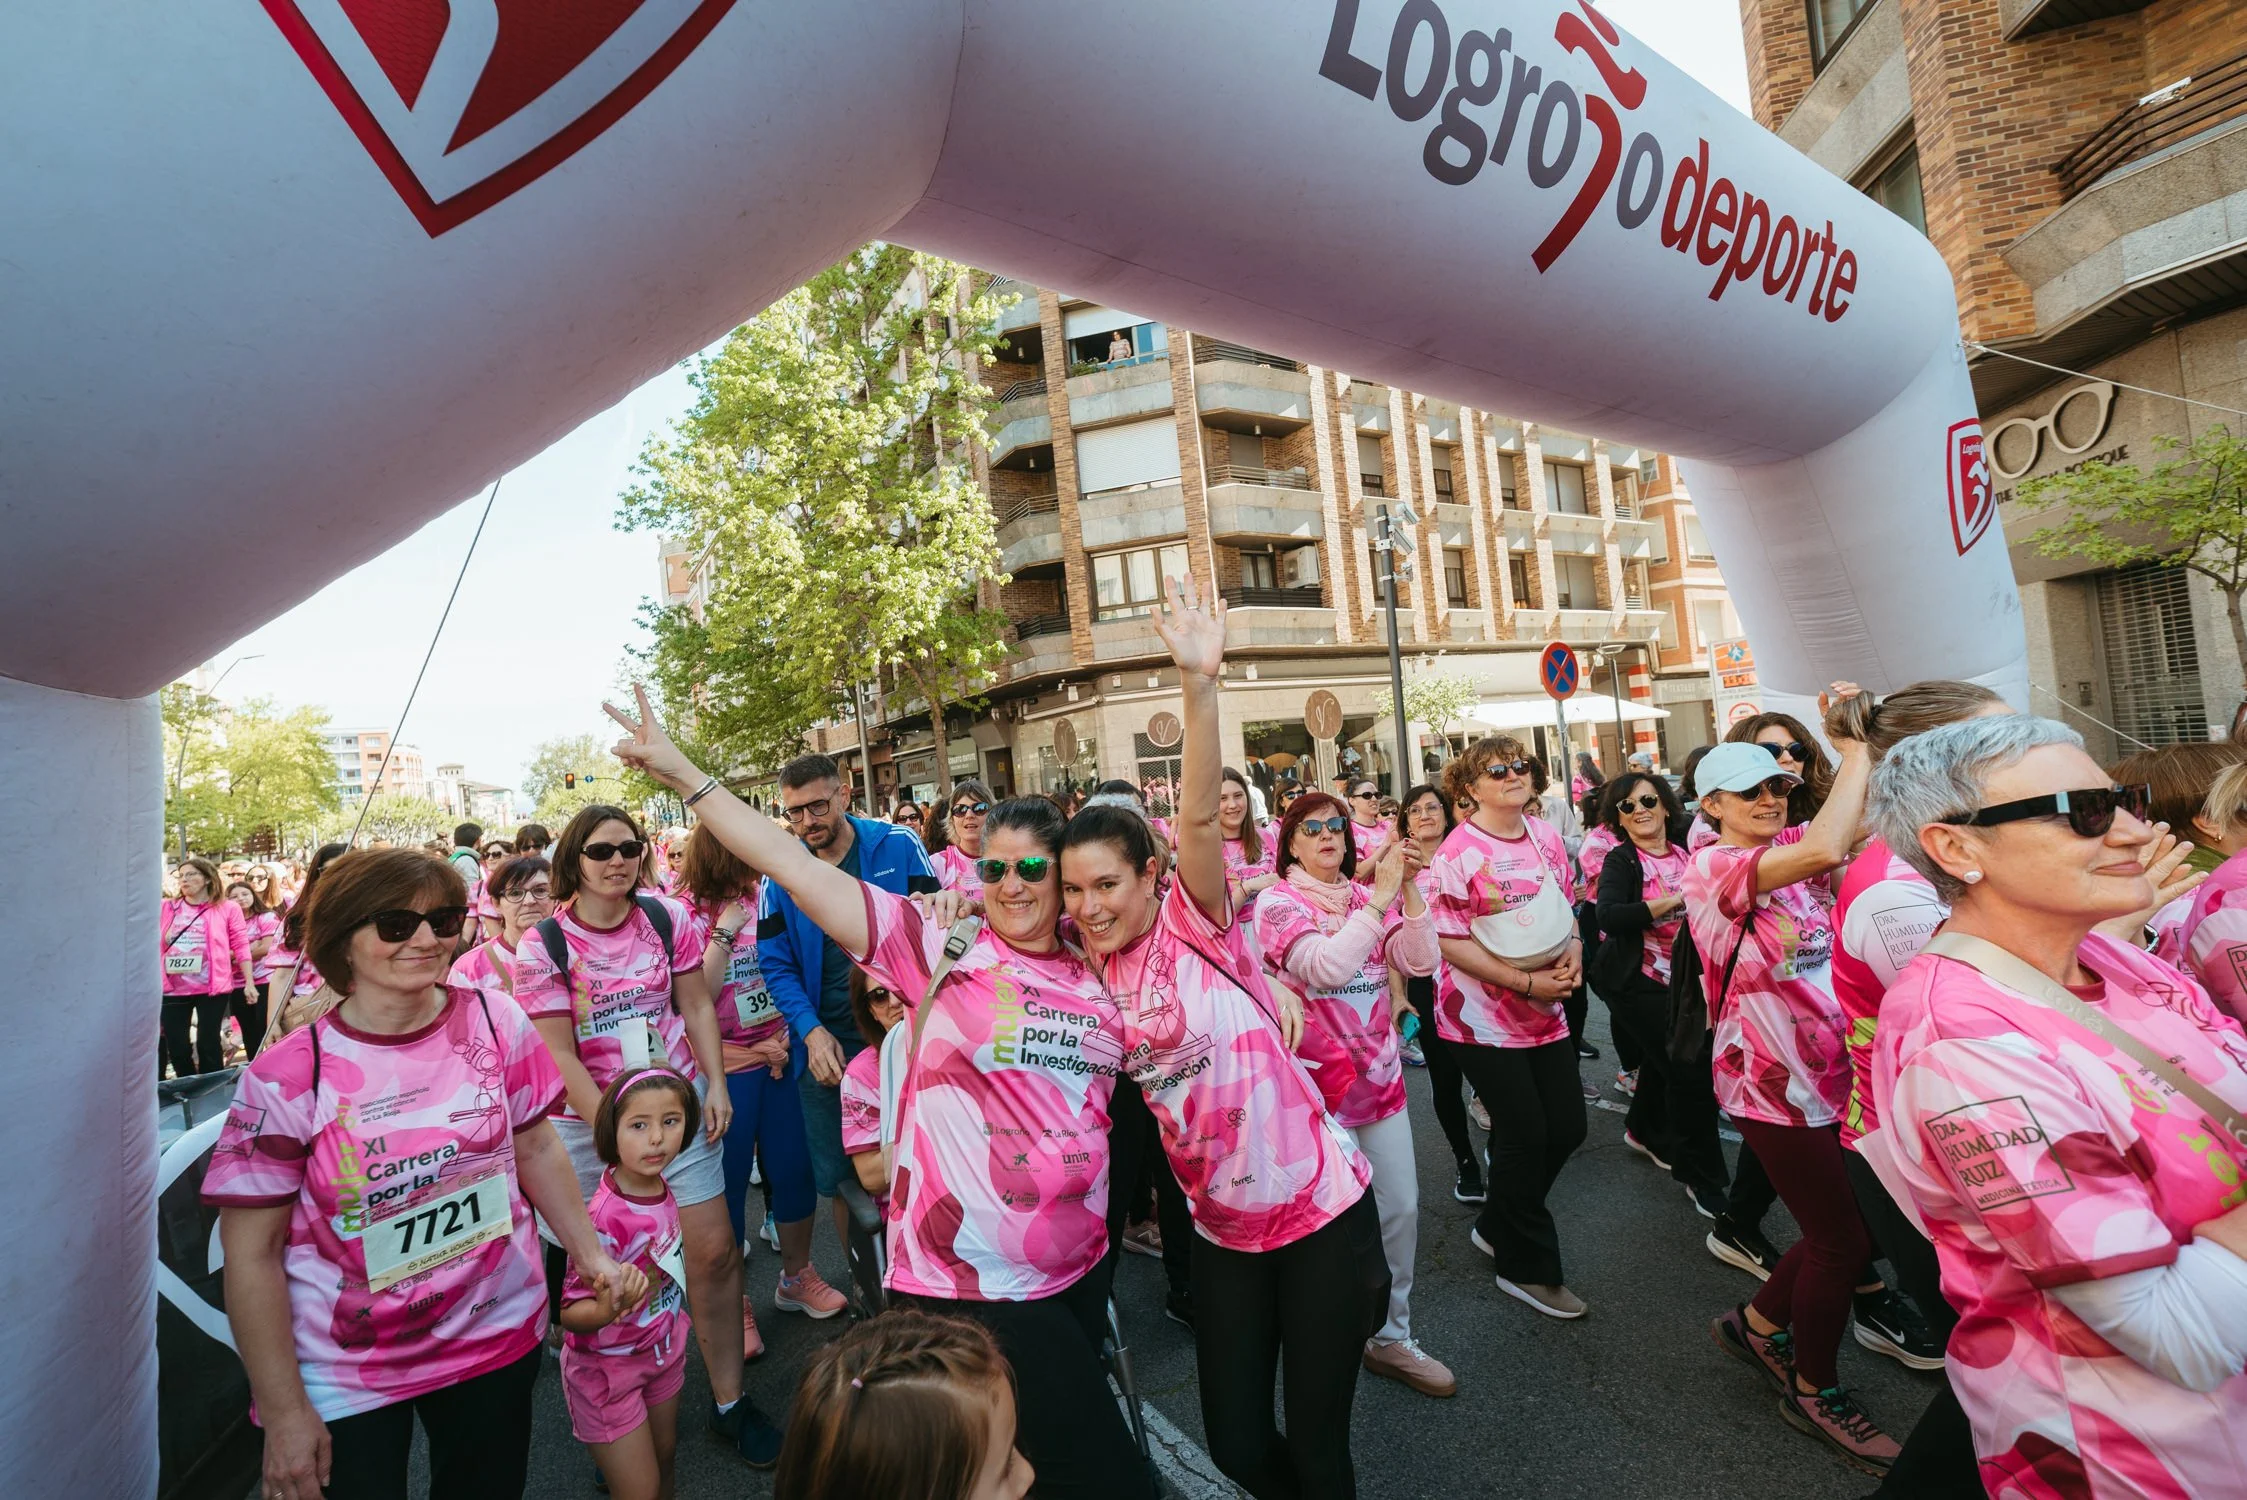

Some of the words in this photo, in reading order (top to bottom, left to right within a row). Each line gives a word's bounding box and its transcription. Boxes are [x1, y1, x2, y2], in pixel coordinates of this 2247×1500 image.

[1660, 137, 1858, 324] deporte
[1995, 488, 2013, 505] THE
[965, 889, 975, 898] XI
[1499, 880, 1512, 891] XI
[1883, 921, 1938, 942] HUMILDA
[1796, 947, 1817, 961] por
[1889, 940, 1918, 955] RUIZ
[169, 958, 195, 968] 7827
[733, 956, 751, 969] por
[590, 979, 603, 991] XI
[591, 984, 645, 1005] Carrera
[1018, 982, 1041, 998] XI
[592, 1006, 617, 1022] por
[618, 1002, 632, 1013] la
[1023, 1000, 1099, 1030] Carrera
[988, 982, 1026, 1065] mujer
[1022, 1026, 1058, 1046] por
[1060, 1029, 1078, 1049] la
[1020, 1047, 1117, 1078] Investigació
[361, 1116, 371, 1124] en
[372, 1113, 382, 1121] La
[382, 1108, 401, 1119] Rioja
[362, 1136, 387, 1158] XI
[366, 1145, 457, 1181] Carrera
[1231, 1175, 1254, 1188] ferrer
[1959, 1160, 2005, 1187] RUIZ
[331, 1141, 368, 1232] mujer
[367, 1184, 410, 1208] por
[413, 1173, 434, 1190] la
[394, 1192, 481, 1254] 7721
[401, 1278, 412, 1290] La
[412, 1271, 434, 1286] Rioja
